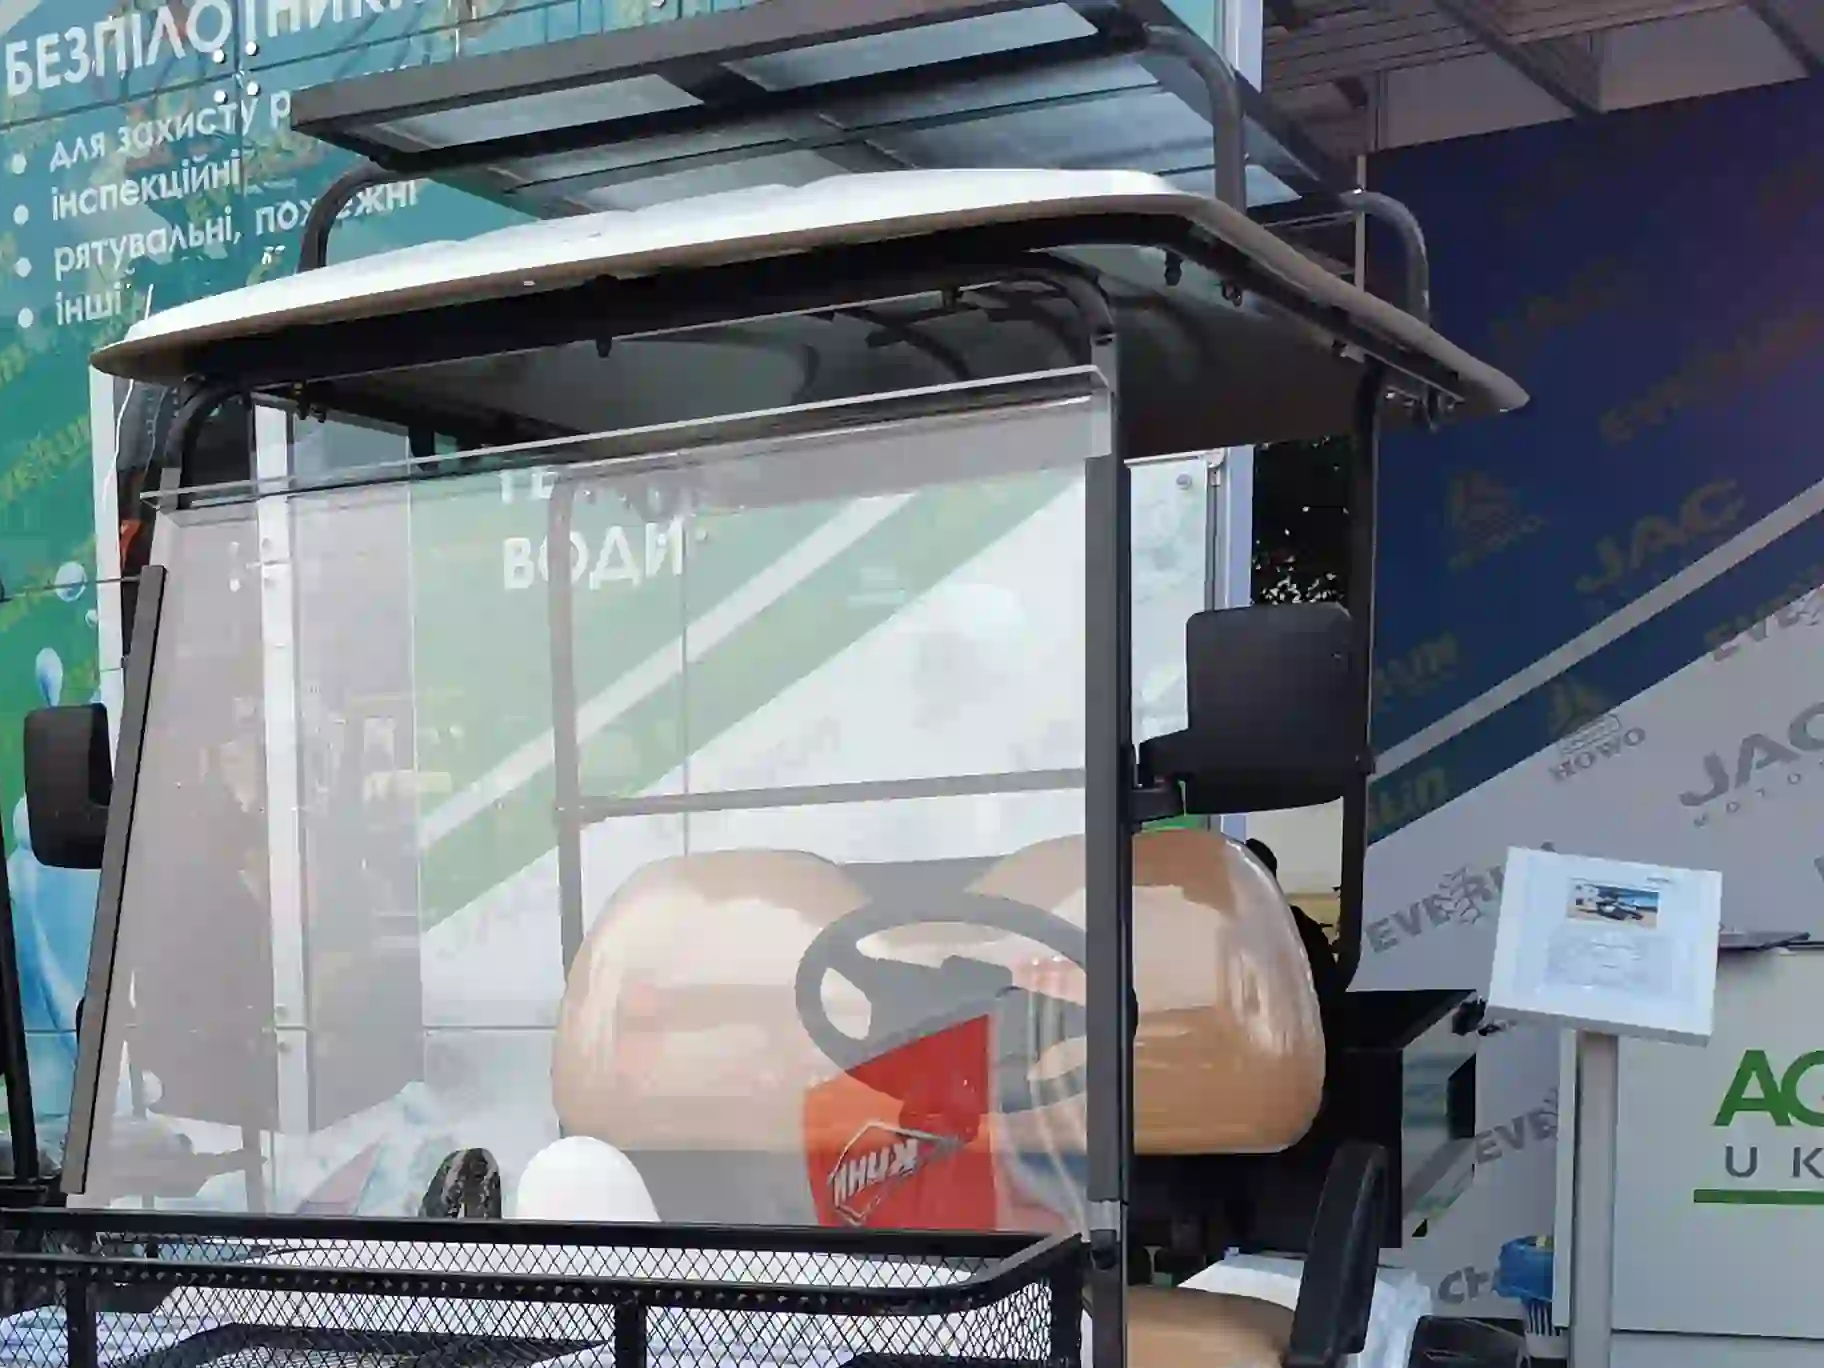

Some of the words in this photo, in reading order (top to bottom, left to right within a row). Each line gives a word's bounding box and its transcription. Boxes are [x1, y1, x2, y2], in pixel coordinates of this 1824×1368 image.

[49, 129, 106, 173] для
[116, 94, 260, 155] захисту
[50, 147, 241, 222] інспекційні
[53, 204, 243, 282] рятувальні,
[56, 283, 122, 327] інші
